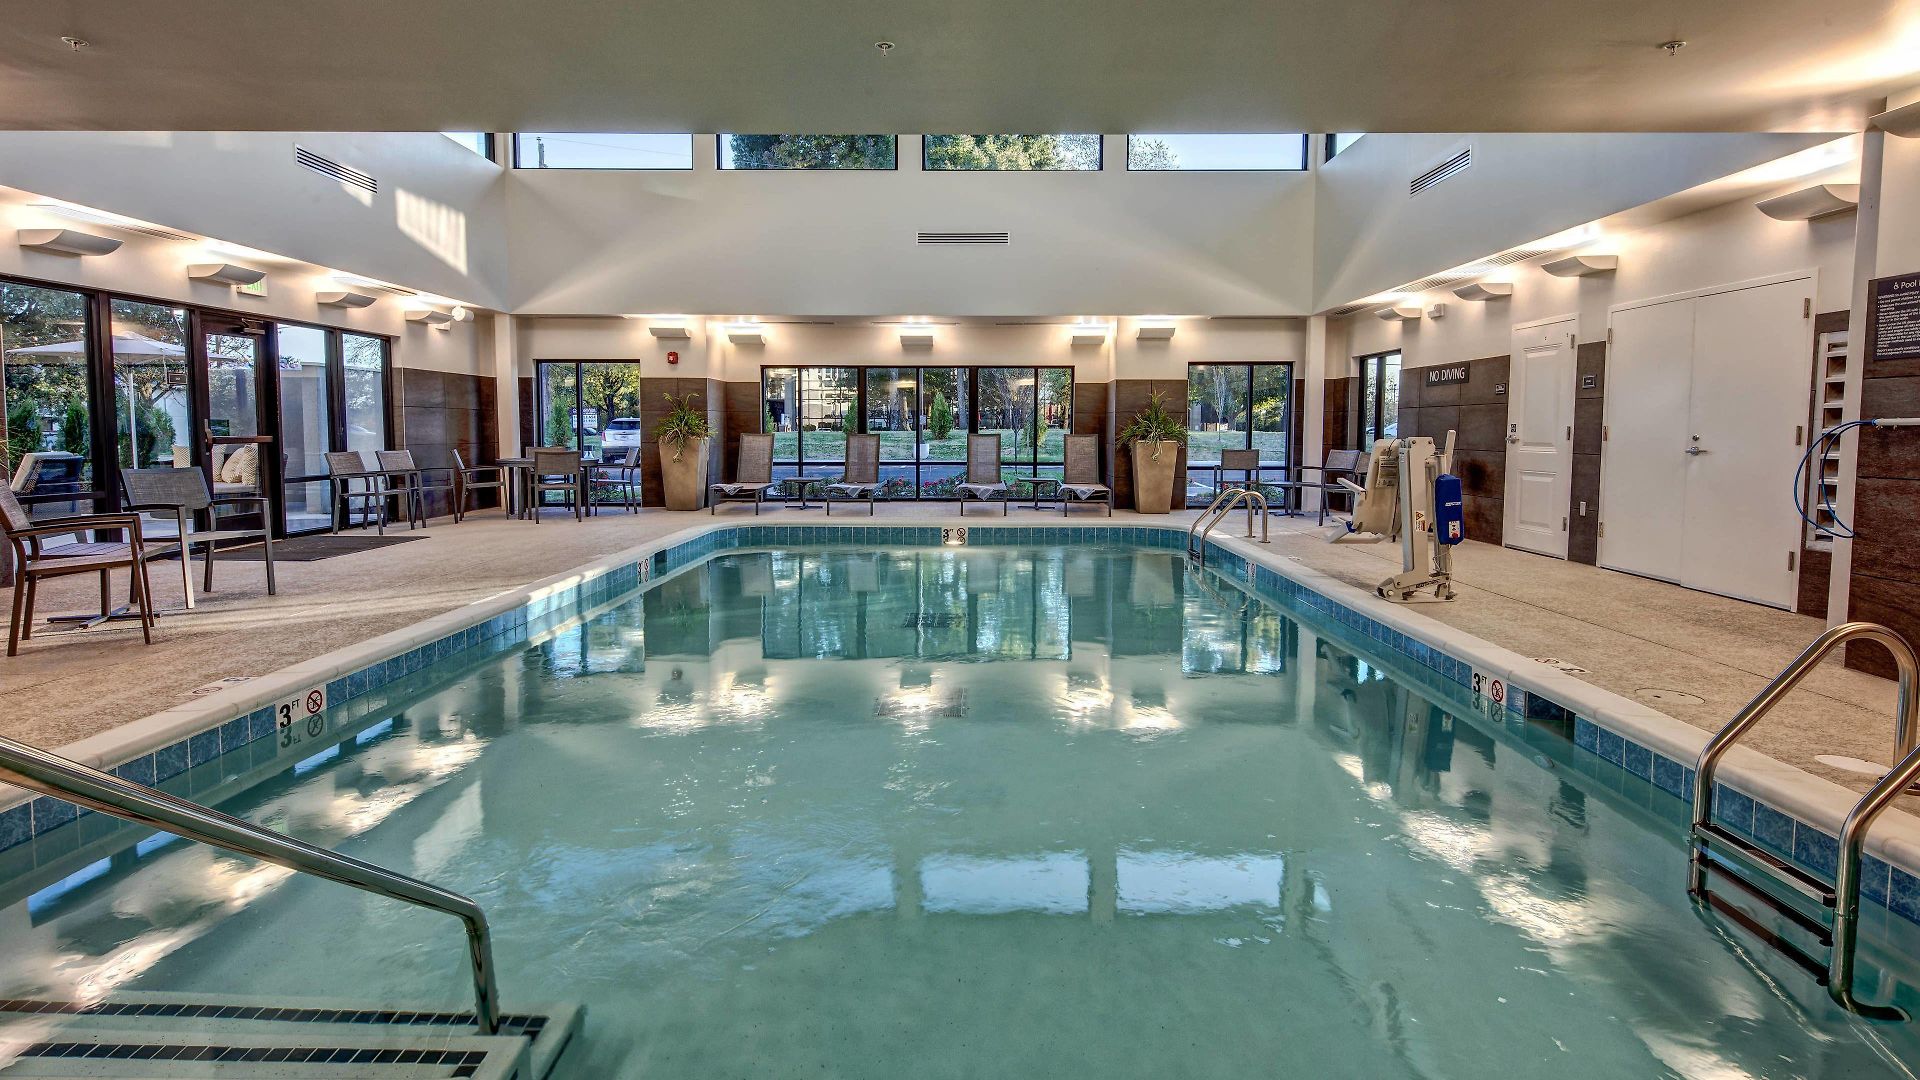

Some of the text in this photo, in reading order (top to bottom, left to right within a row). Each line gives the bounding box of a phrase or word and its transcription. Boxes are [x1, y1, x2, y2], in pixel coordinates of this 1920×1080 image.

[1901, 280, 1917, 289] Pool
[1430, 367, 1465, 382] NO DIVING
[943, 528, 950, 539] 3
[1473, 672, 1481, 693] 3
[279, 698, 301, 728] 3 FT
